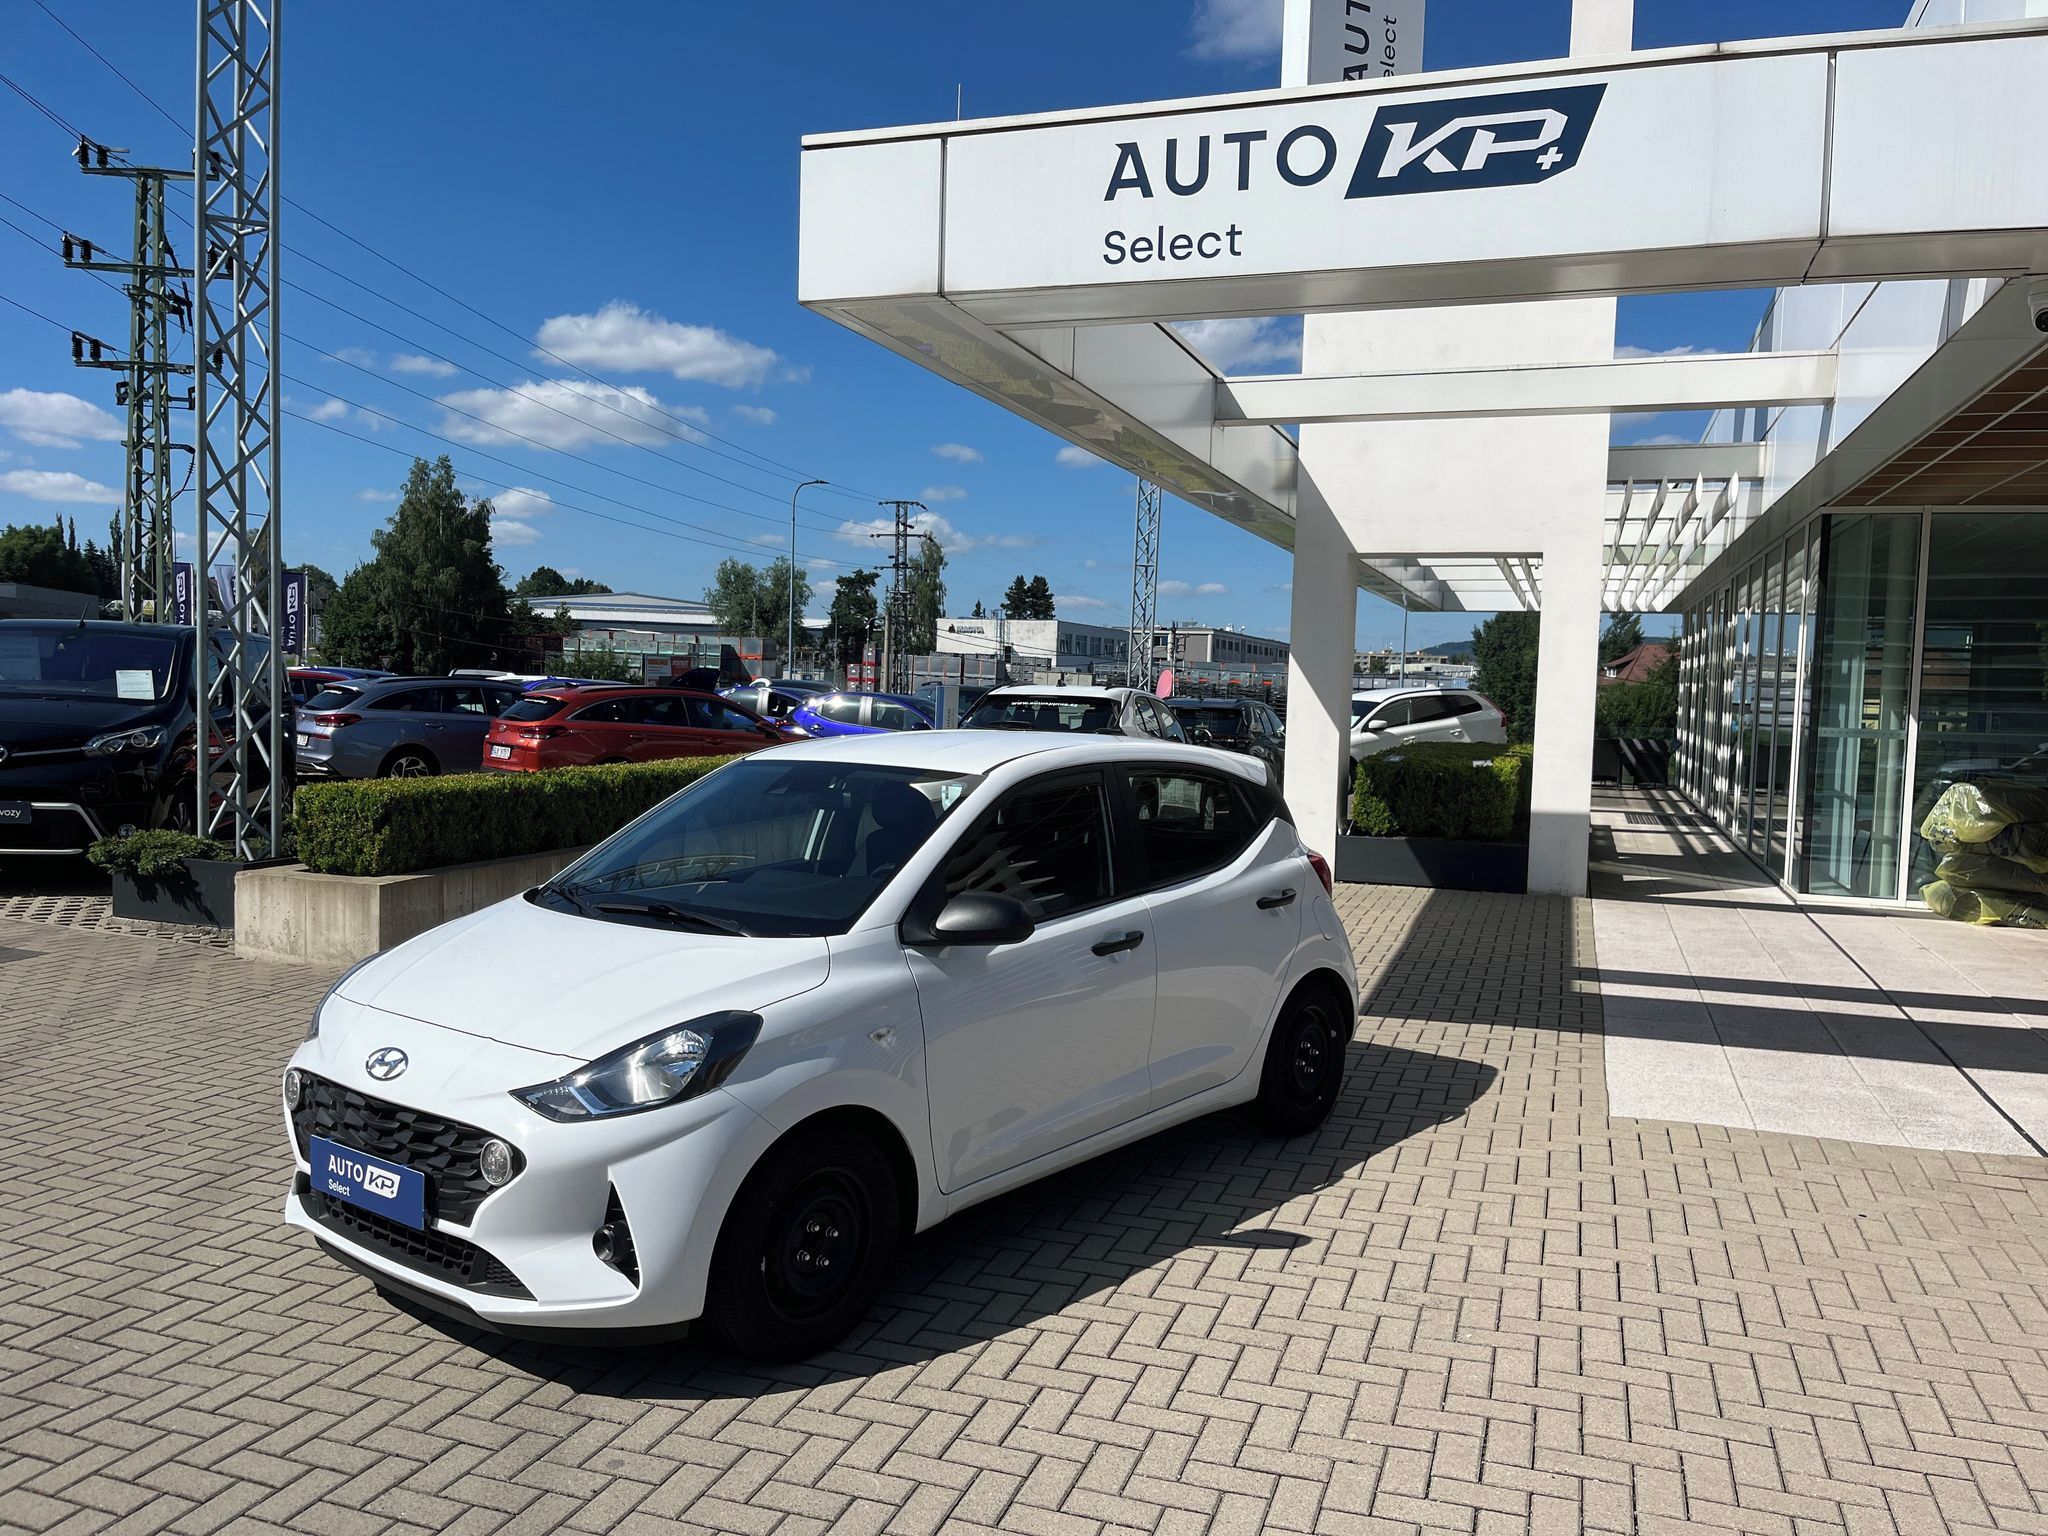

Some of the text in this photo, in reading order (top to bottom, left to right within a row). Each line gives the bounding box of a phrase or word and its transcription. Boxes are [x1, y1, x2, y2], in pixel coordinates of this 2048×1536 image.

[1343, 0, 1371, 81] AUT
[1380, 15, 1397, 77] elect
[1104, 125, 1337, 201] AUTO
[1103, 224, 1243, 265] Select
[328, 1154, 363, 1183] AUTO
[328, 1178, 351, 1197] Select
